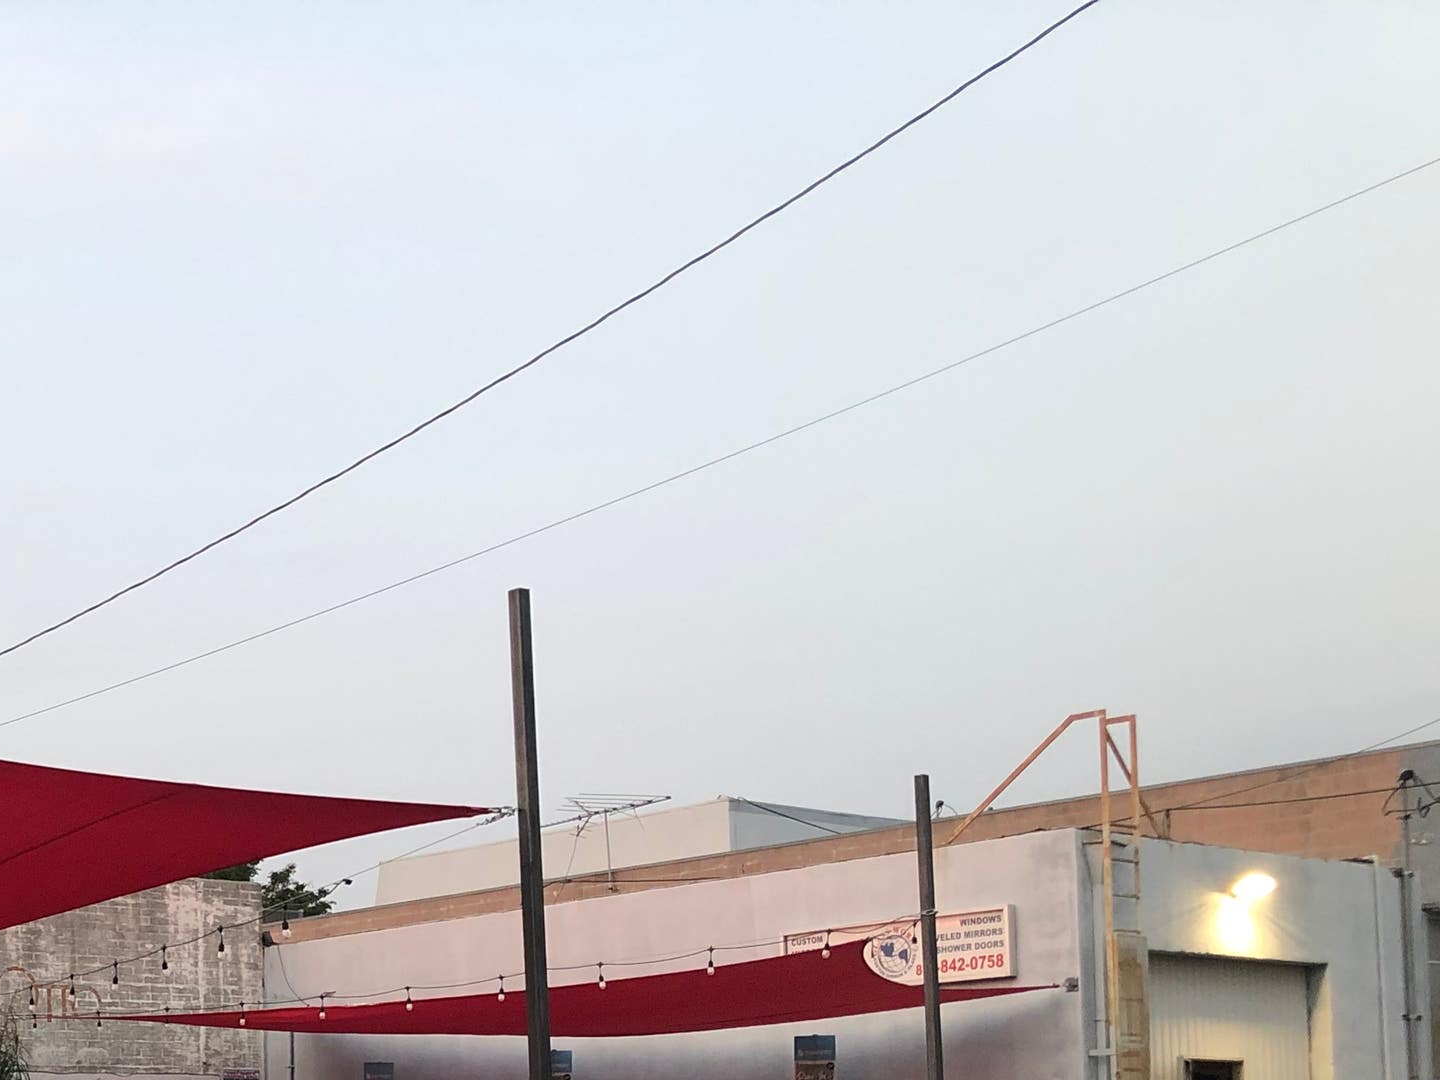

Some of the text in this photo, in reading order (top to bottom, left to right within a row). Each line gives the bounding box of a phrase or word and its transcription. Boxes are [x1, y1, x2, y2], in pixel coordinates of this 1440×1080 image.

[959, 914, 1003, 927] WINDOWS
[790, 935, 824, 948] CUSTOM
[936, 927, 1004, 942] VELED MIRRORS
[936, 939, 1005, 955] SHOWER DOORS
